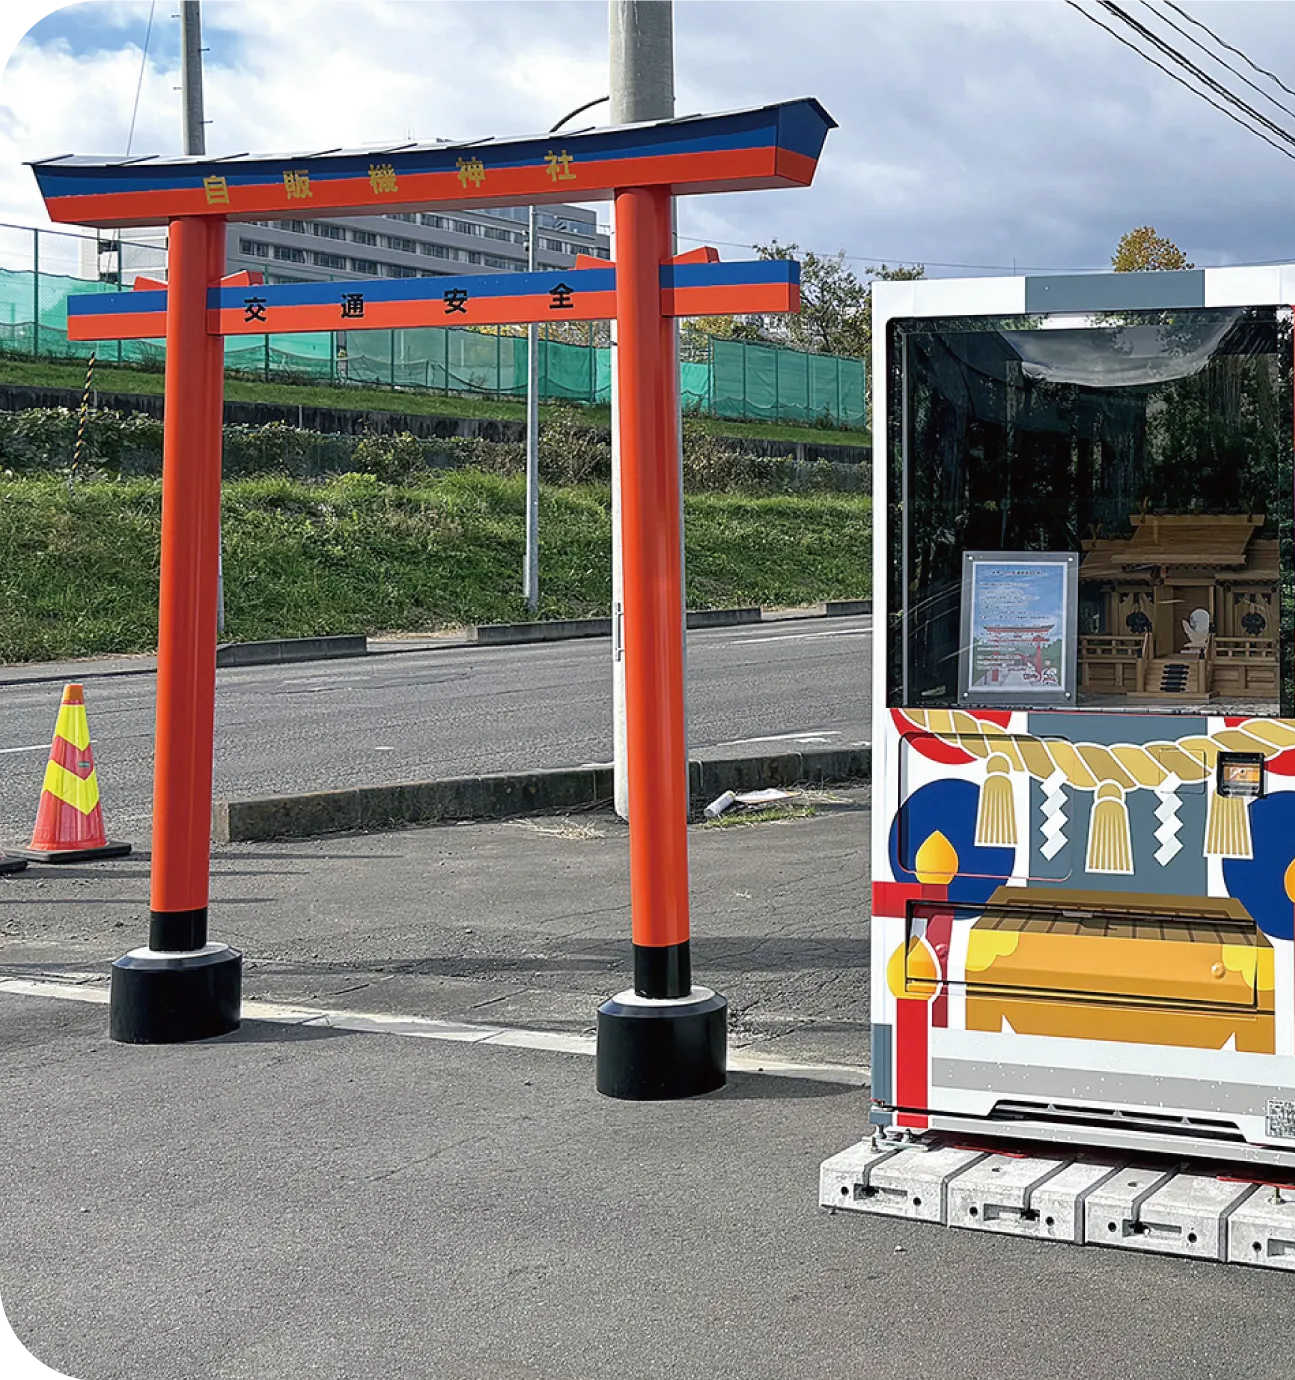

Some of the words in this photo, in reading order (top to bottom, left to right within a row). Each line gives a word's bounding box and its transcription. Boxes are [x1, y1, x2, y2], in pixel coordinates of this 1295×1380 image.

[203, 149, 578, 206] 自販機神社
[242, 282, 576, 323] 交通安全
